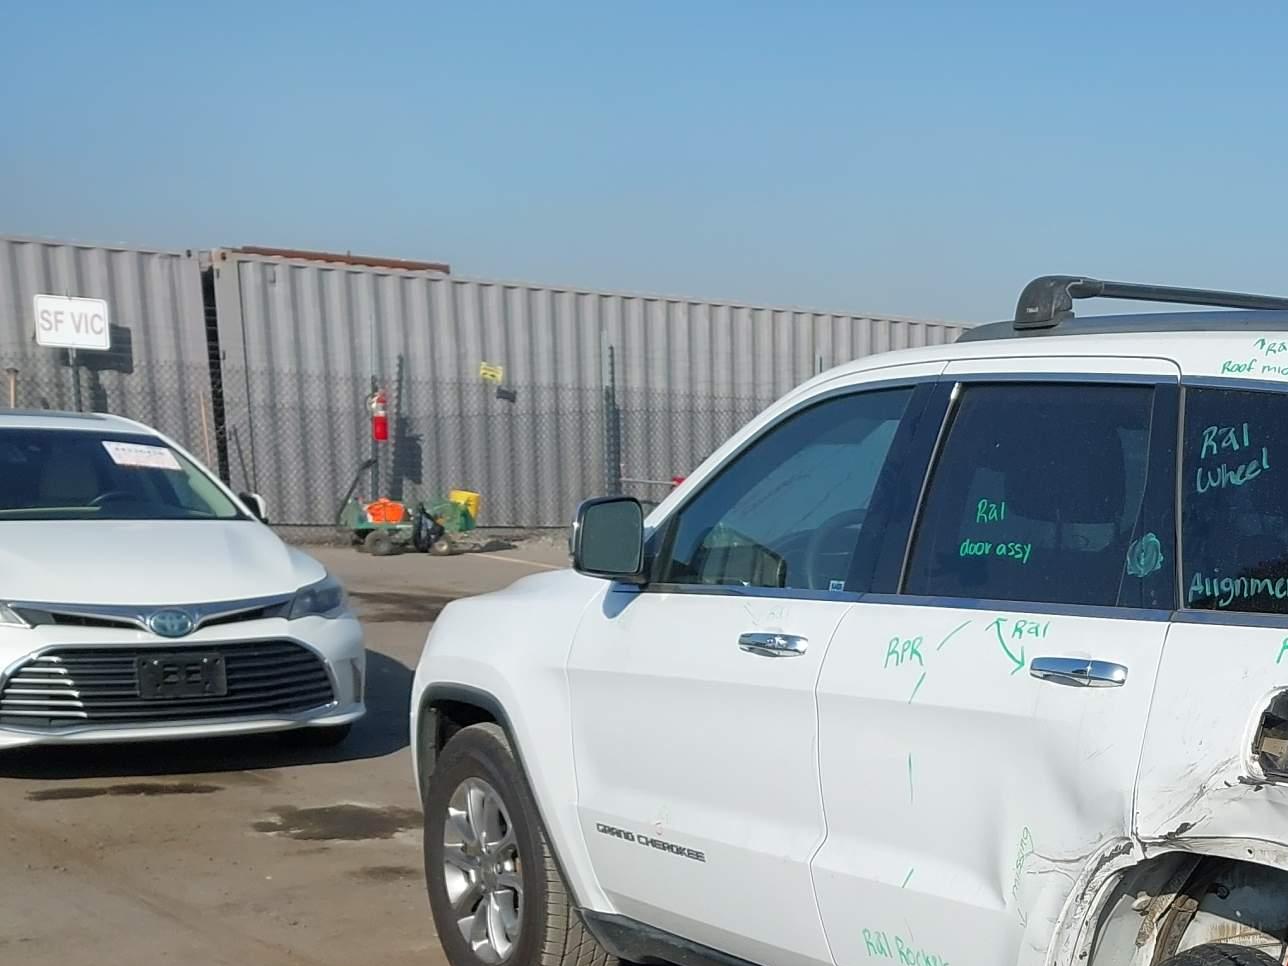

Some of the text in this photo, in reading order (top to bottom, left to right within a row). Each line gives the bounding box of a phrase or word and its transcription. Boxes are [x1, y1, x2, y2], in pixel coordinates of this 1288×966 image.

[40, 309, 104, 335] SF VIC
[1221, 358, 1258, 374] Roof
[1196, 447, 1271, 493] Wheel
[959, 538, 1032, 564] door assy
[883, 636, 925, 669] RPR
[595, 822, 706, 863] GRAND CHEROKEE
